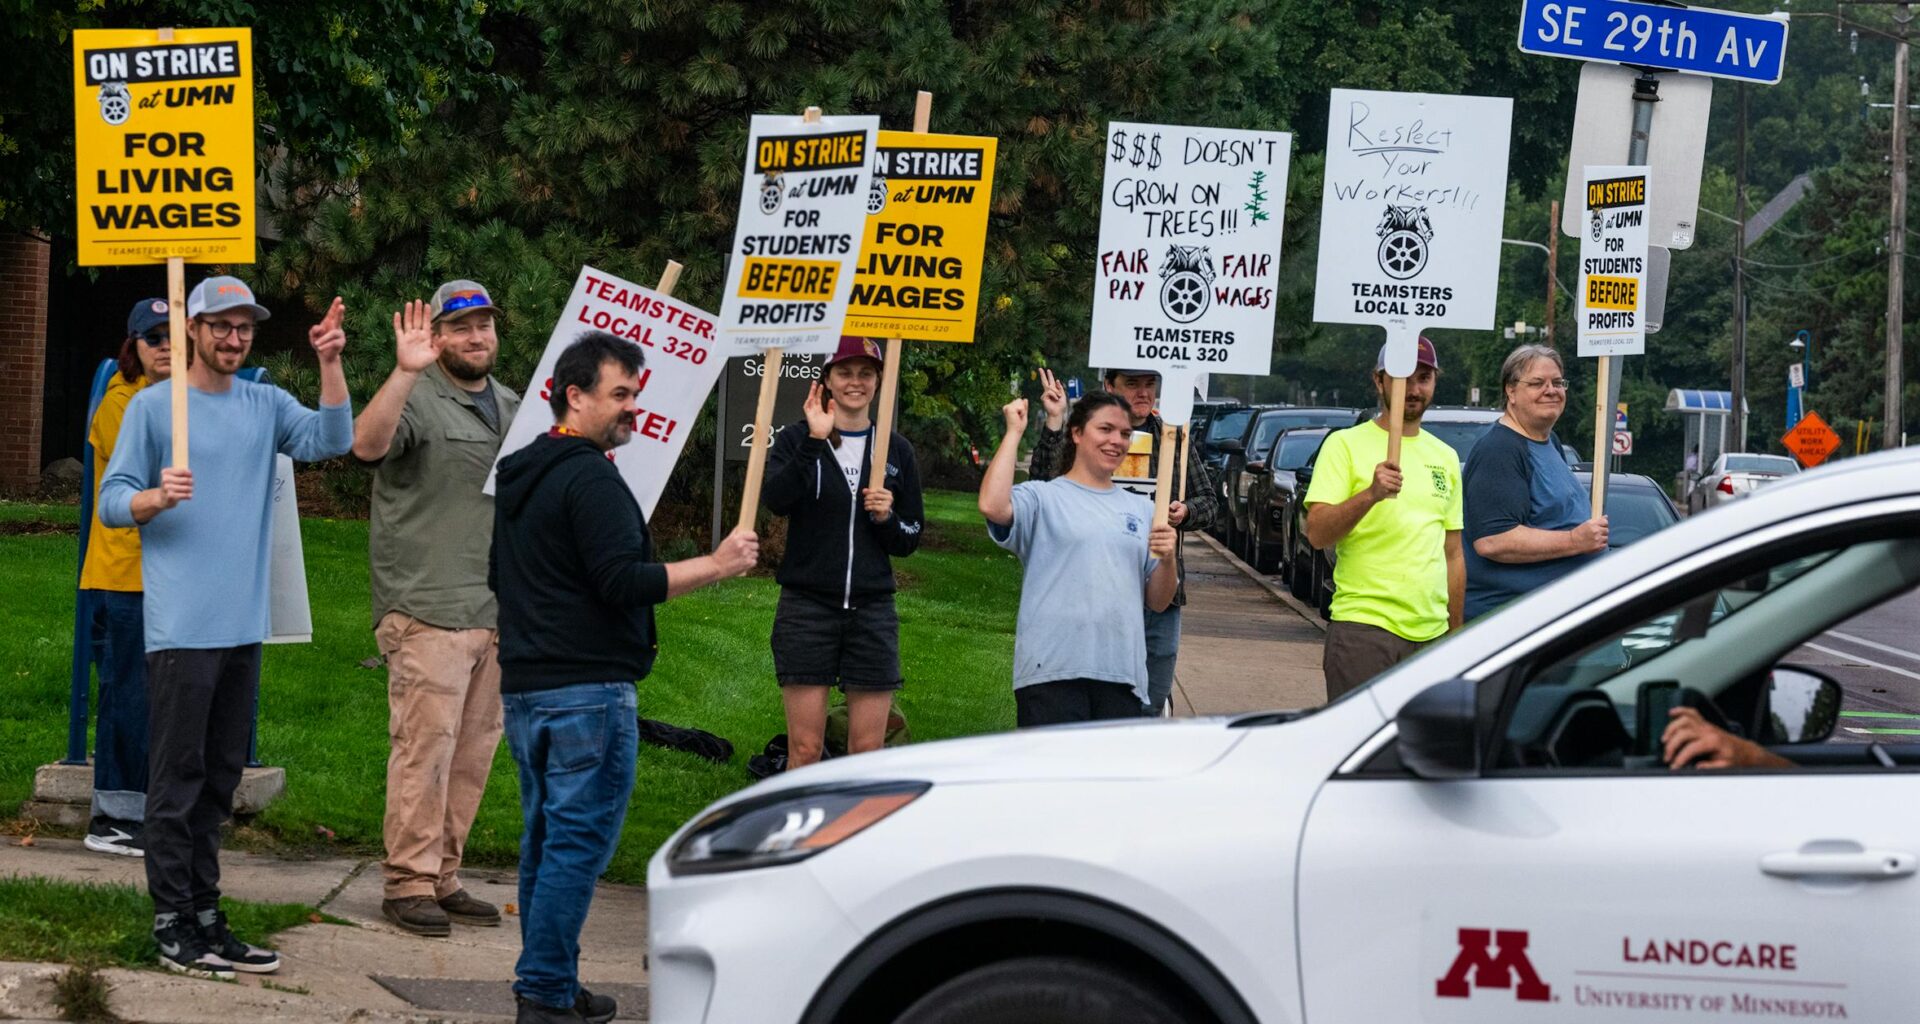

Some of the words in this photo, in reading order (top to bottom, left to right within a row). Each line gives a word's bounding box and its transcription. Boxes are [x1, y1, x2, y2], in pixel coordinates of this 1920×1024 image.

[1538, 3, 1587, 46] SE
[1603, 11, 1697, 60] 29th
[1715, 26, 1768, 68] Av
[90, 53, 128, 80] ON
[135, 46, 235, 77] STRIKE
[138, 89, 162, 109] at
[165, 84, 235, 107] UMN
[124, 132, 206, 157] FOR
[759, 141, 789, 168] ON
[793, 135, 864, 167] STRIKE
[1111, 129, 1162, 171] $$$
[1184, 137, 1277, 167] DOESN'T
[874, 151, 890, 174] N
[896, 152, 978, 176] STRIKE
[97, 167, 233, 193] LIVING
[788, 179, 807, 198] at
[807, 174, 858, 198] UMN
[893, 186, 914, 202] at
[915, 186, 975, 204] UMN
[1112, 178, 1179, 213] GROW
[1191, 182, 1220, 207] ON
[1589, 183, 1604, 206] ON
[1606, 180, 1644, 204] STRIKE
[90, 202, 241, 229] WAGES
[784, 210, 820, 228] FOR
[1143, 209, 1238, 238] TREES!!!
[1605, 214, 1615, 229] at
[1615, 210, 1643, 229] UMN
[741, 234, 852, 256] STUDENTS
[876, 222, 944, 247] FOR
[1605, 238, 1624, 252] FOR
[108, 247, 168, 255] TEAMSTERS
[171, 246, 203, 254] LOCAL
[207, 245, 227, 253] 320
[1101, 248, 1149, 277] FAIR
[1223, 253, 1272, 278] FAIR
[1584, 257, 1642, 275] STUDENTS
[746, 263, 835, 294] BEFORE
[1110, 279, 1145, 301] PAY
[1215, 286, 1273, 309] WAGES
[1352, 283, 1453, 301] TEAMSTERS
[1590, 280, 1635, 305] BEFORE
[738, 302, 827, 324] PROFITS
[1354, 300, 1409, 316] LOCAL
[1415, 303, 1446, 317] 320
[1589, 312, 1635, 330] PROFITS
[578, 305, 655, 347] LOCAL
[662, 336, 707, 366] 320
[850, 321, 900, 330] TEAMSTERS
[903, 323, 929, 332] LOCAL
[1133, 326, 1235, 345] TEAMSTERS
[1136, 344, 1191, 361] LOCAL
[1196, 348, 1228, 362] 320
[1796, 427, 1826, 435] UTILITY
[1623, 937, 1798, 971] LANDCARE
